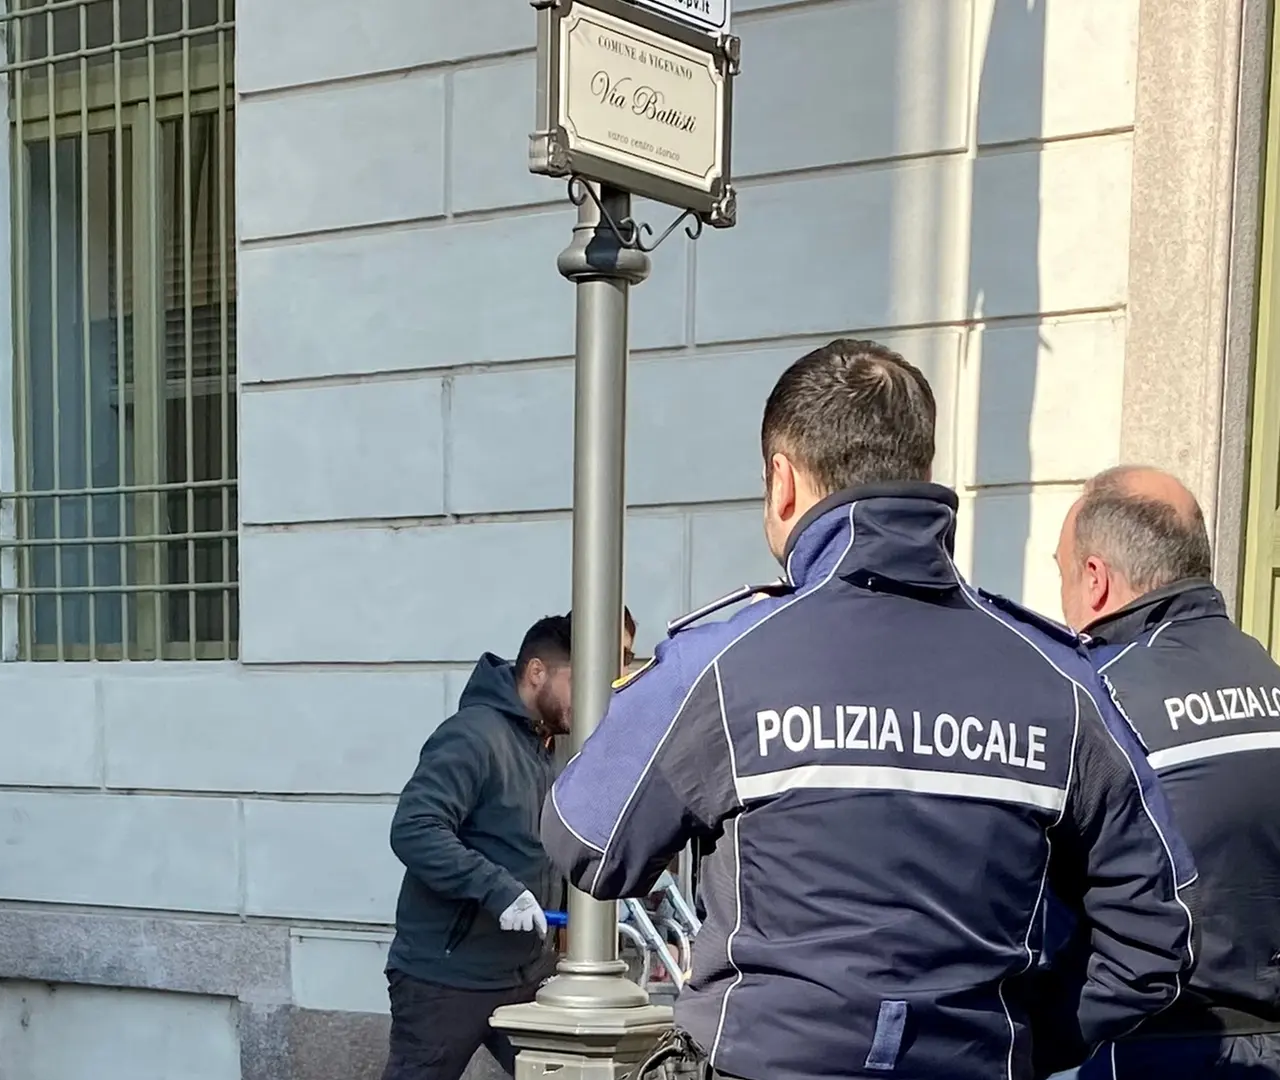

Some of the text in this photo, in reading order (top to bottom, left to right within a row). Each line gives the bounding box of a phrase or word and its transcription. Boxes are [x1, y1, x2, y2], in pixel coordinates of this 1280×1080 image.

[598, 35, 637, 61] COMUNE
[649, 54, 693, 80] VIGEVANO
[591, 70, 696, 134] Via Battisti
[631, 138, 655, 153] centro
[1164, 686, 1266, 731] POLIZIA
[756, 705, 1047, 771] POLIZIA LOCALE
